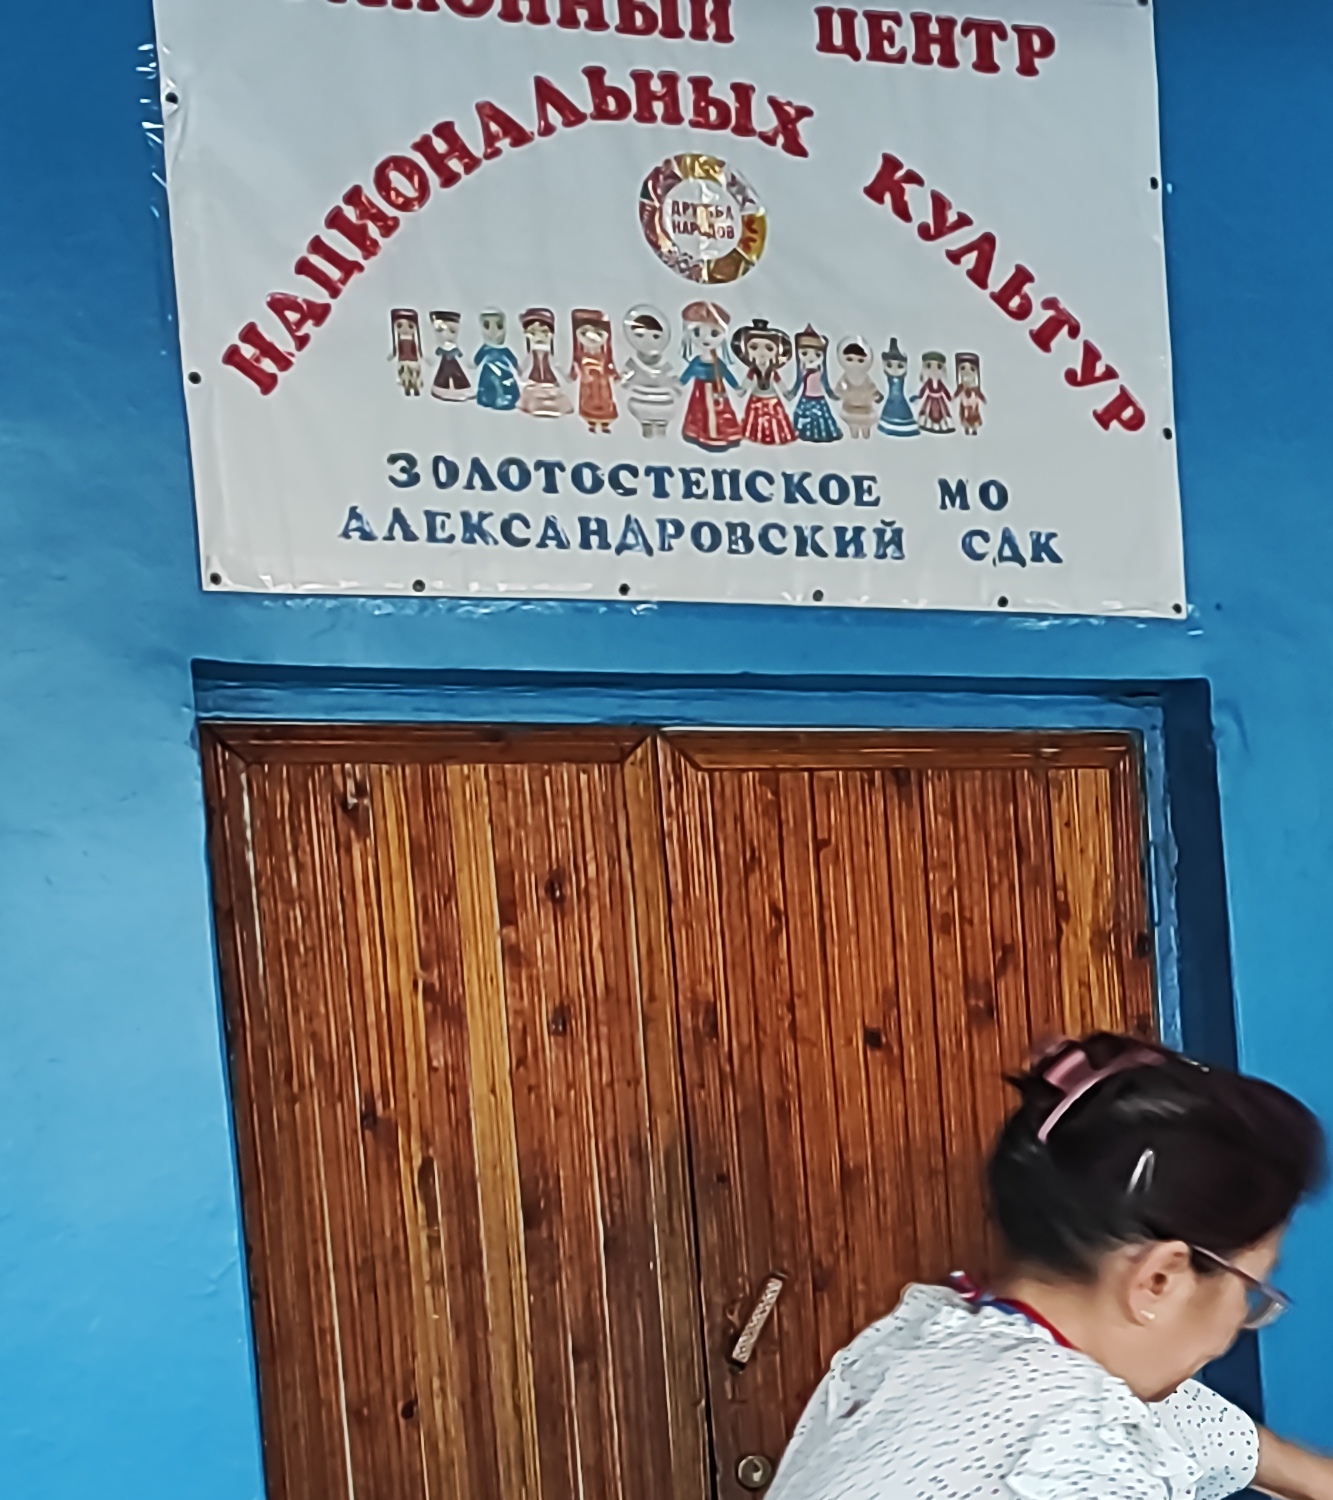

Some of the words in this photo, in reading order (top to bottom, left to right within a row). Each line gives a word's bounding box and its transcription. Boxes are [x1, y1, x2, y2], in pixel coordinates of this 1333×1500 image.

[815, 5, 1056, 78] ЦЕНТР
[222, 65, 814, 395] НАЦИОНАЛЬНЫХ
[863, 153, 1146, 432] КУЛЬТУР
[387, 452, 880, 507] ЗОЛОТОСТЕПСКОЕ
[938, 478, 1009, 511] МО
[339, 505, 905, 560] АЛЕКСАНДРОВСКИЙ
[961, 527, 1063, 568] СДК
